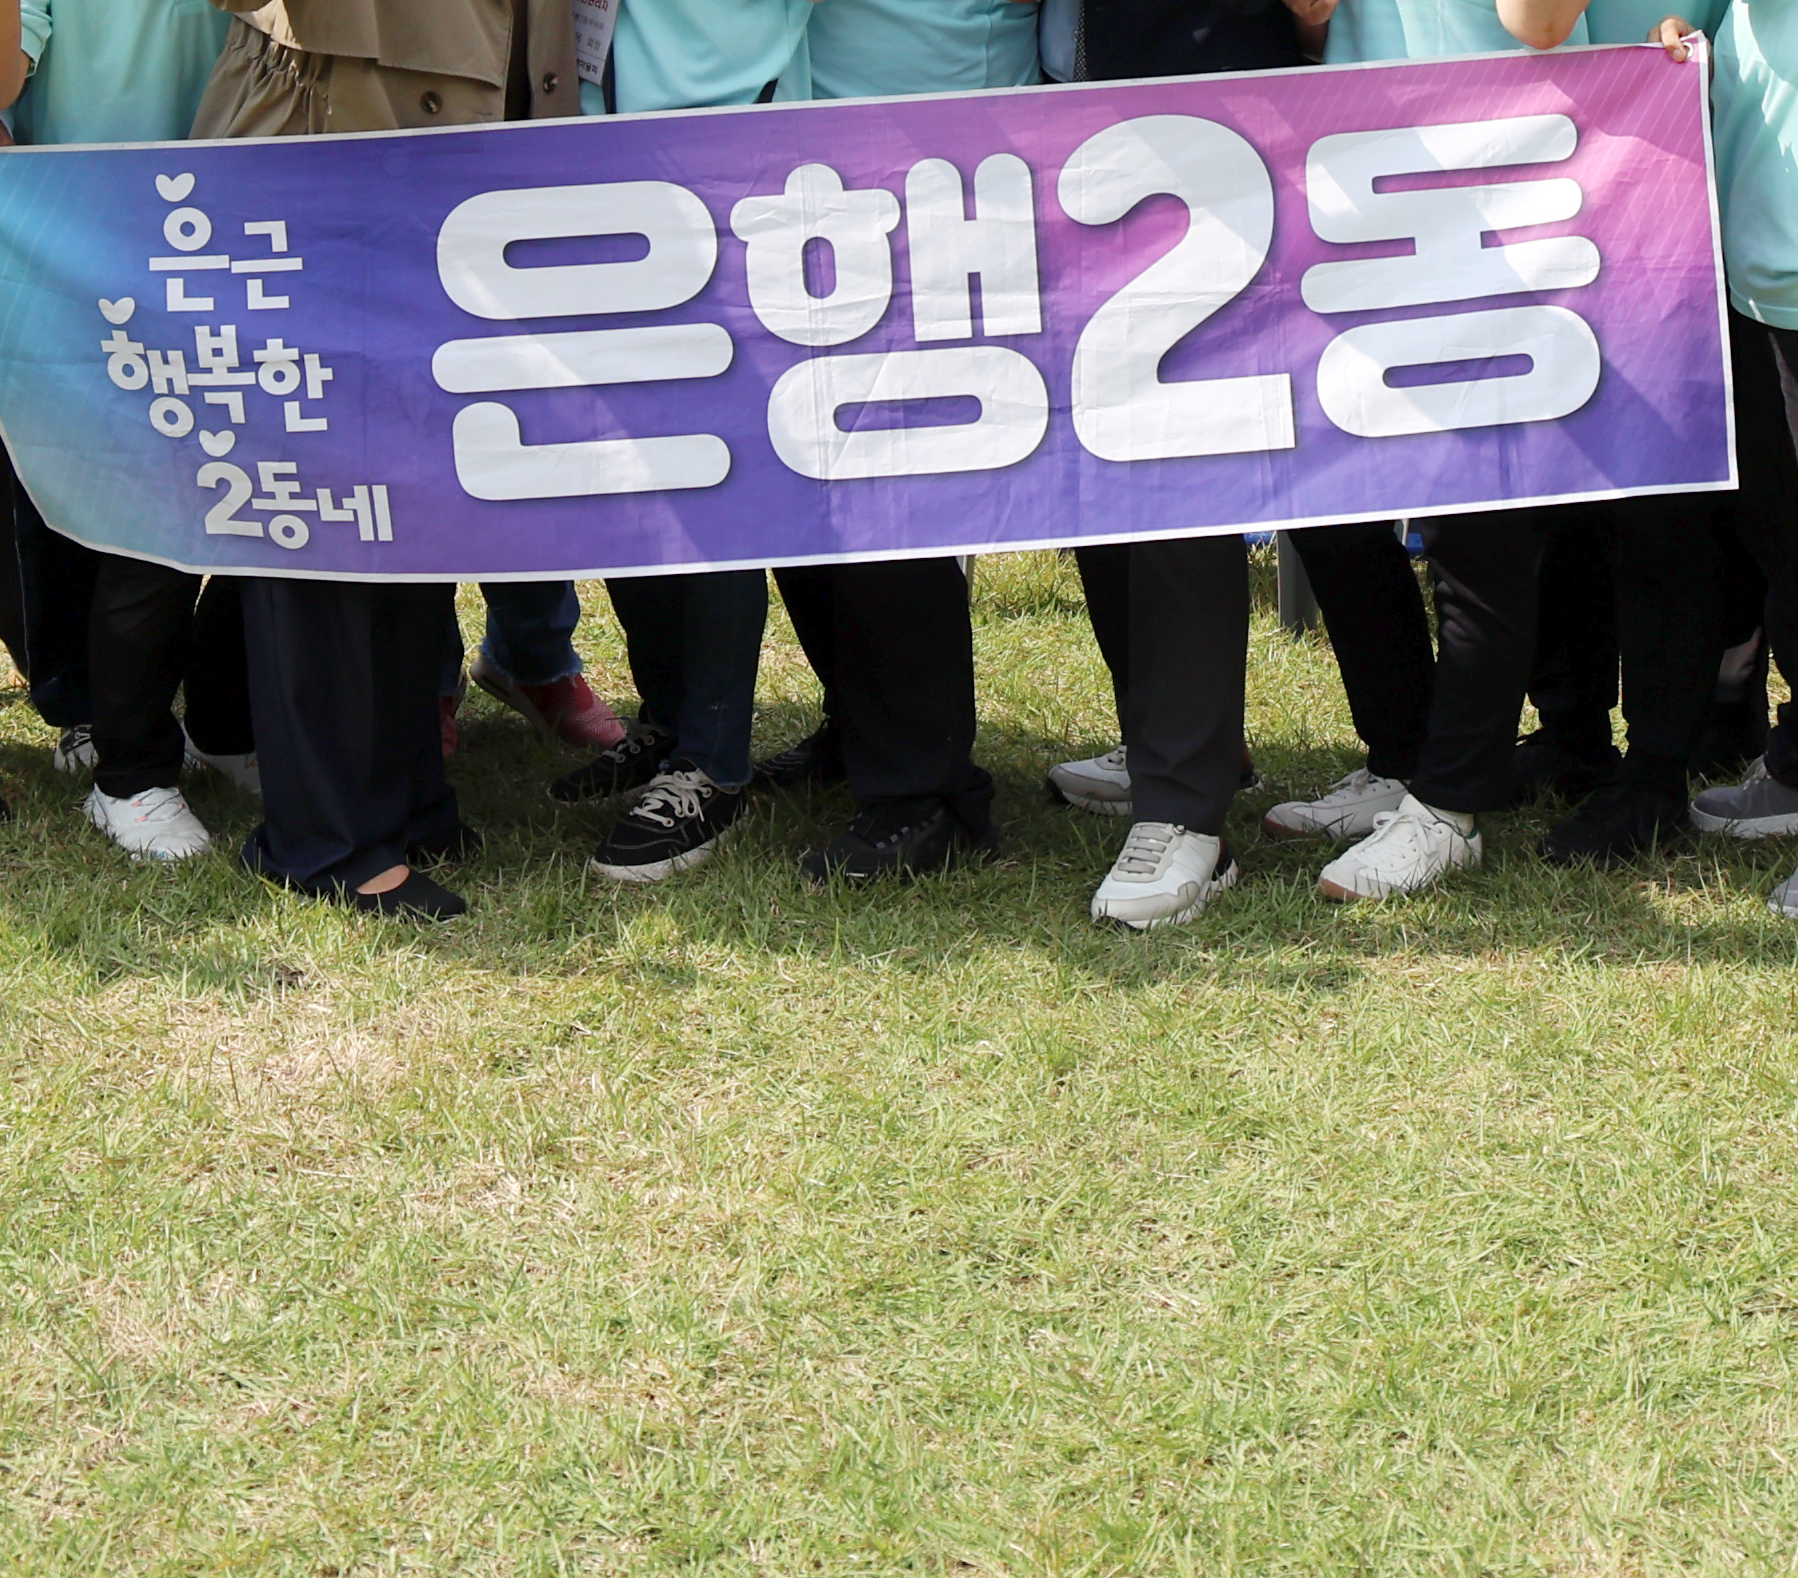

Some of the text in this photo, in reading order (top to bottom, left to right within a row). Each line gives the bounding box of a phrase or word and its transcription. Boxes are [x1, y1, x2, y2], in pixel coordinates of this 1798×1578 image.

[149, 206, 303, 312] 은근
[432, 114, 1600, 500] 은행2동
[99, 323, 333, 438] 행복한
[195, 460, 393, 549] 2동네
